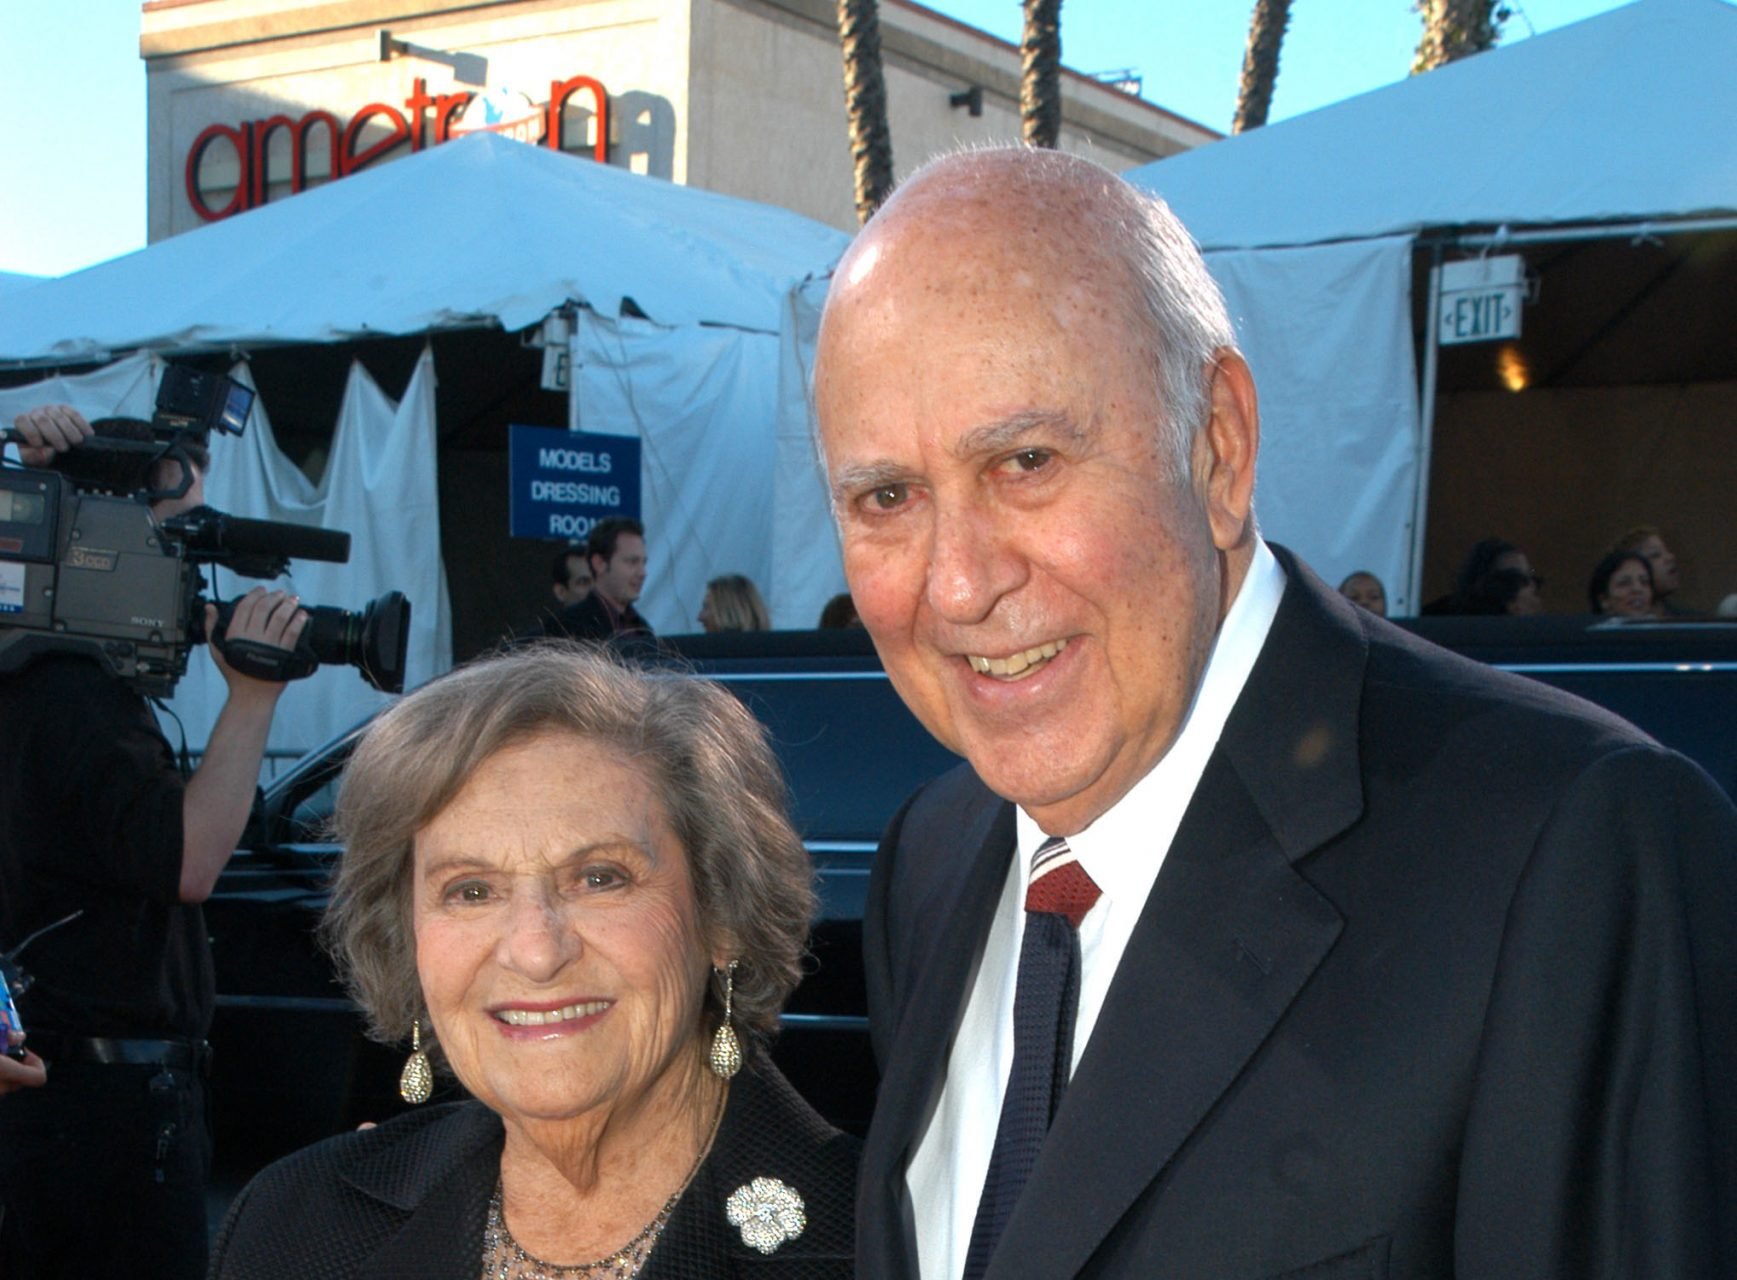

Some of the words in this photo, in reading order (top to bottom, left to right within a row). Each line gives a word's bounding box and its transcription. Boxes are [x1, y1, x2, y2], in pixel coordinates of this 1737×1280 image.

[185, 76, 608, 222] ametrn
[1456, 293, 1505, 337] EXIT
[540, 449, 611, 472] MODELS
[531, 481, 620, 506] DRESSING
[130, 616, 164, 628] SONY
